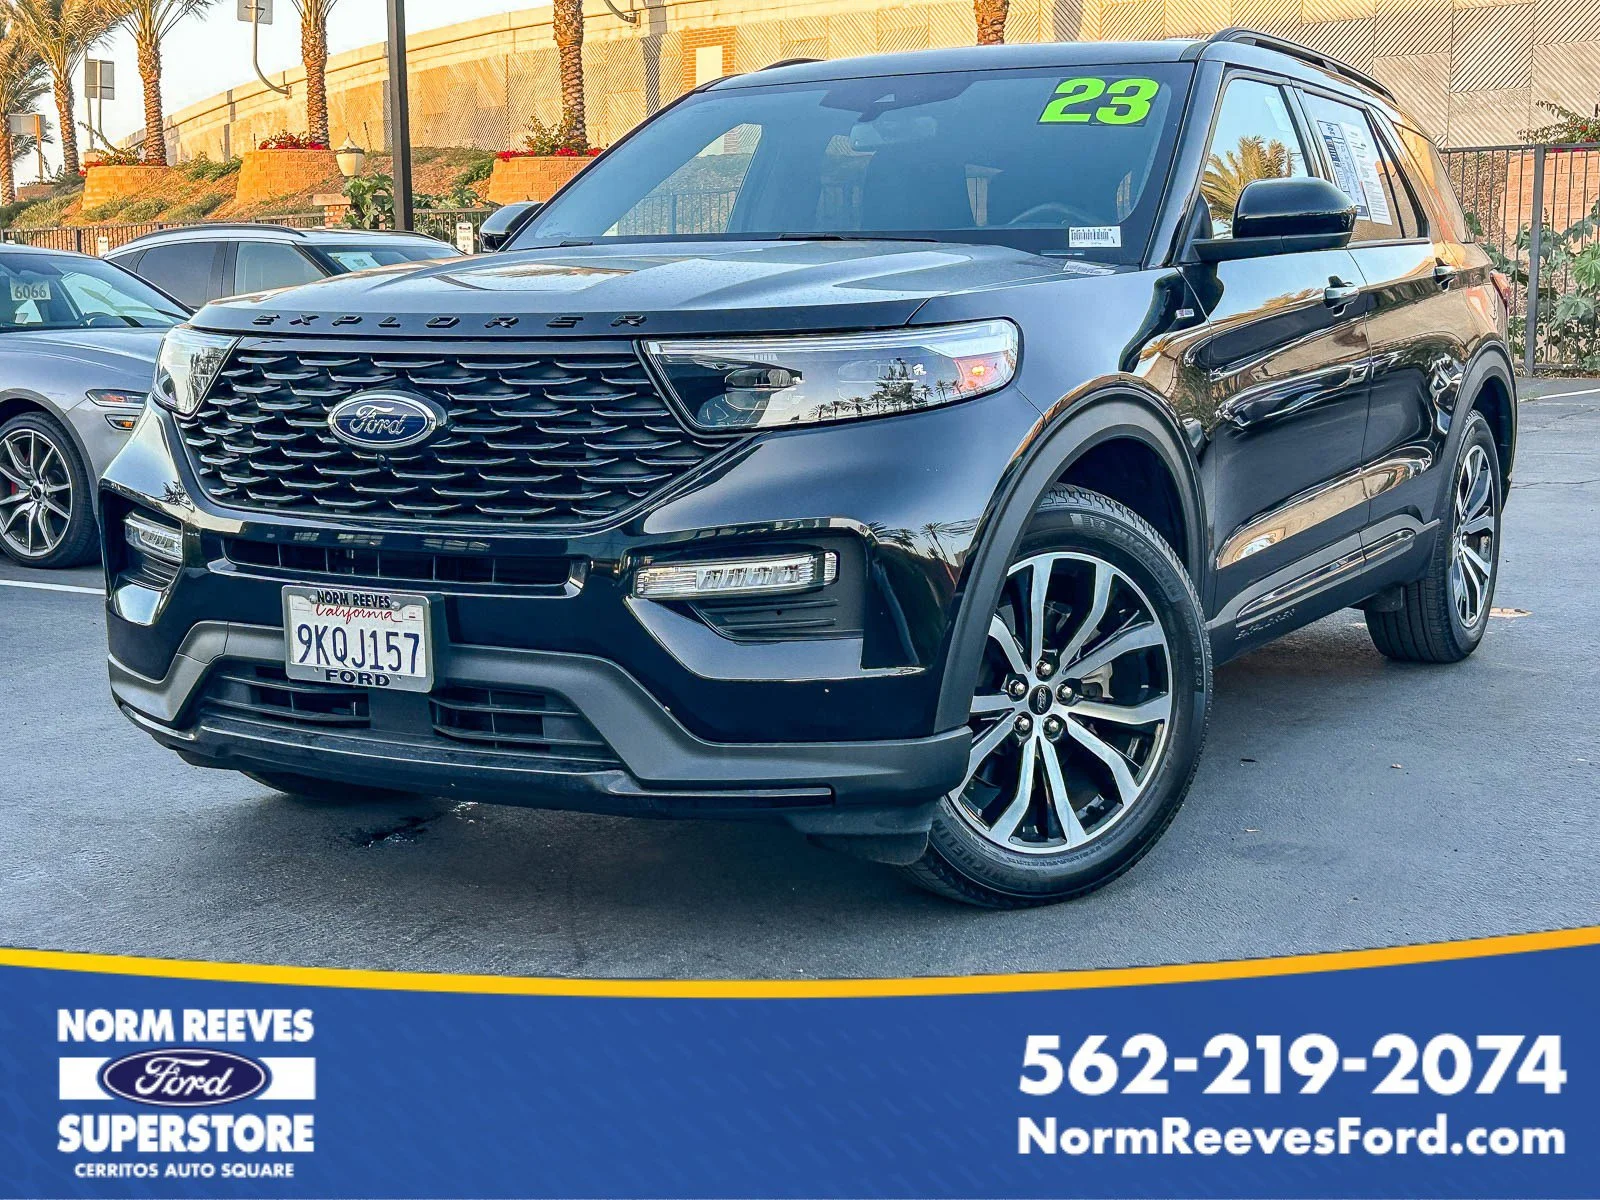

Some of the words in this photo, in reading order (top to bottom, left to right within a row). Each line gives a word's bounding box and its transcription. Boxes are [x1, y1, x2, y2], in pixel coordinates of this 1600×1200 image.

[1039, 77, 1159, 125] 23
[14, 284, 47, 299] 6066
[252, 314, 648, 329] EXPLORER
[349, 404, 406, 436] Ford
[316, 590, 349, 606] NORM
[352, 593, 391, 609] REEVES
[315, 603, 403, 625] California
[297, 623, 420, 675] 9KQJ157
[324, 668, 391, 687] FORD
